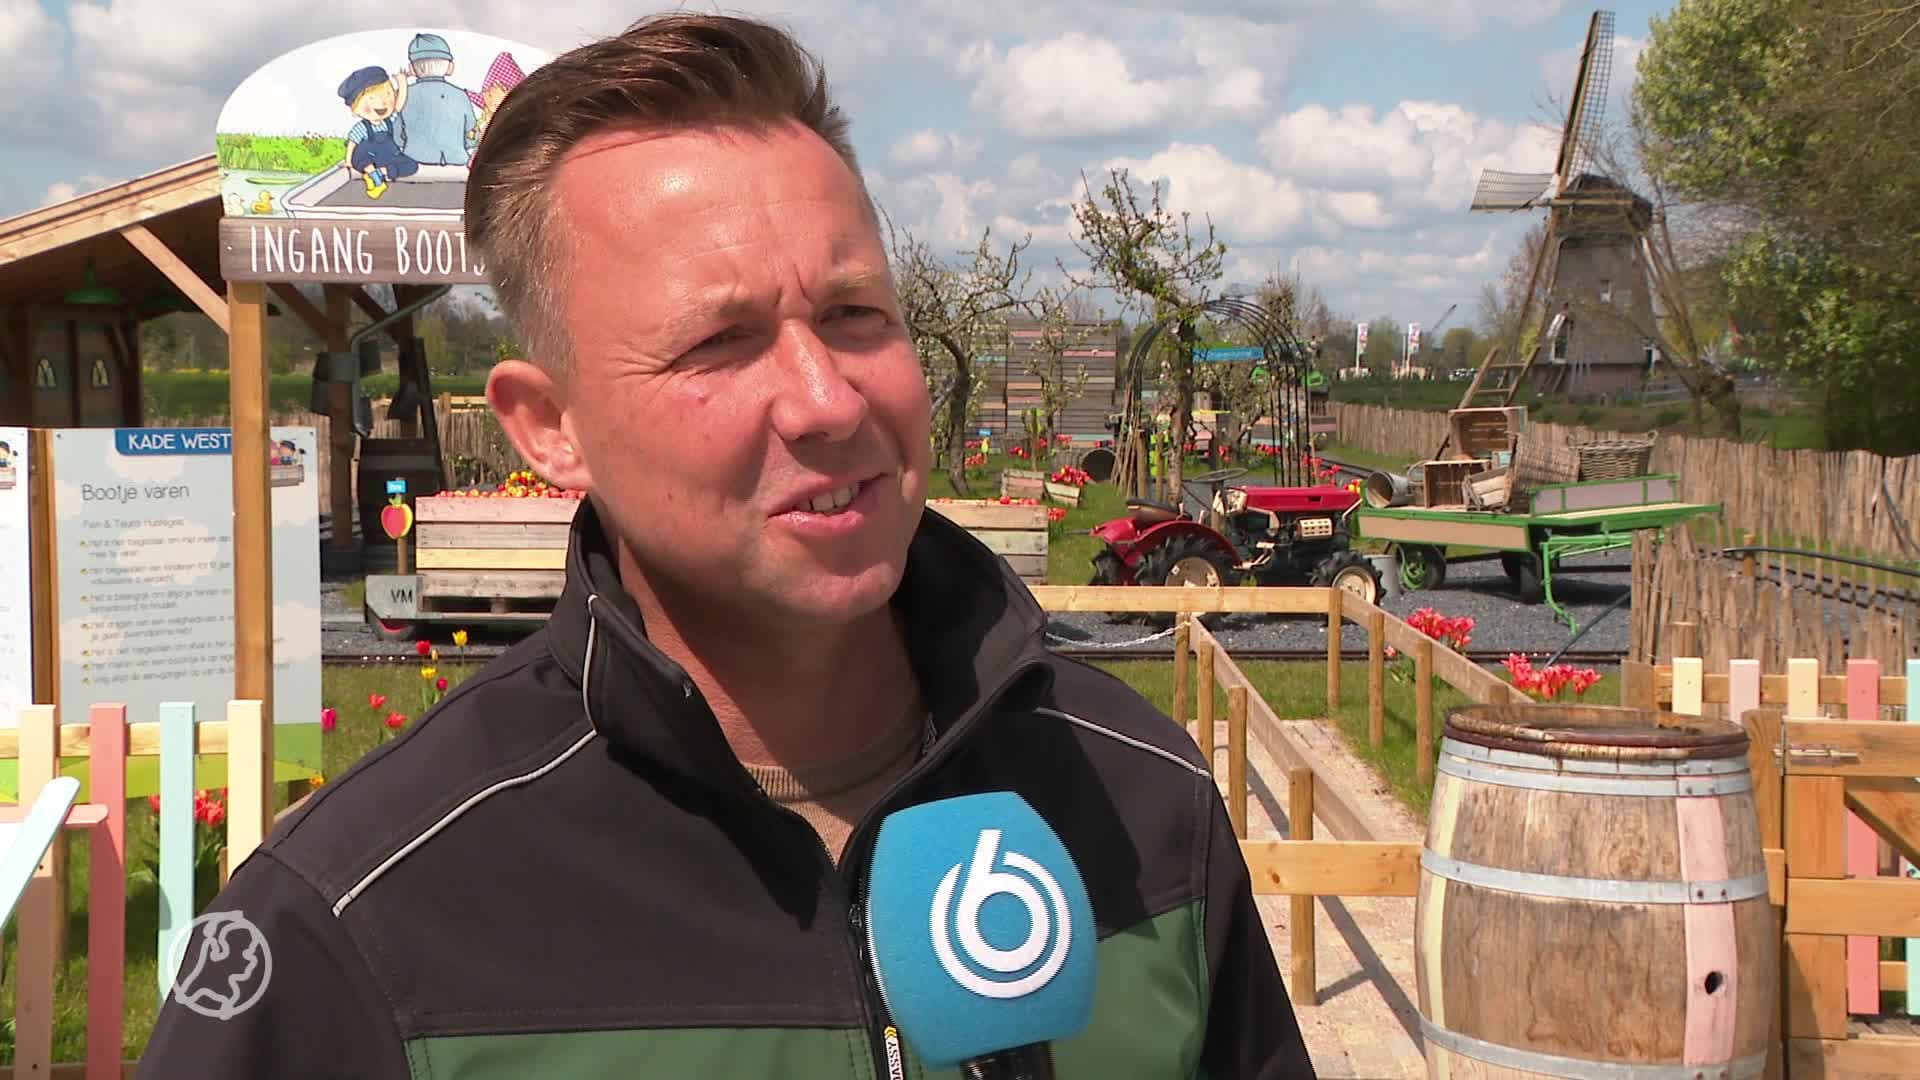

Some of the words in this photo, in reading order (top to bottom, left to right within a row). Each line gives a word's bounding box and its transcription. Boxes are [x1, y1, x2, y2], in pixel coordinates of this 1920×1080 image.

[251, 225, 373, 275] INGANG
[128, 433, 177, 450] KADE
[180, 432, 232, 449] WEST
[82, 483, 138, 504] Bootje
[144, 485, 190, 499] varen
[390, 589, 413, 603] VM
[956, 829, 1051, 973] 6
